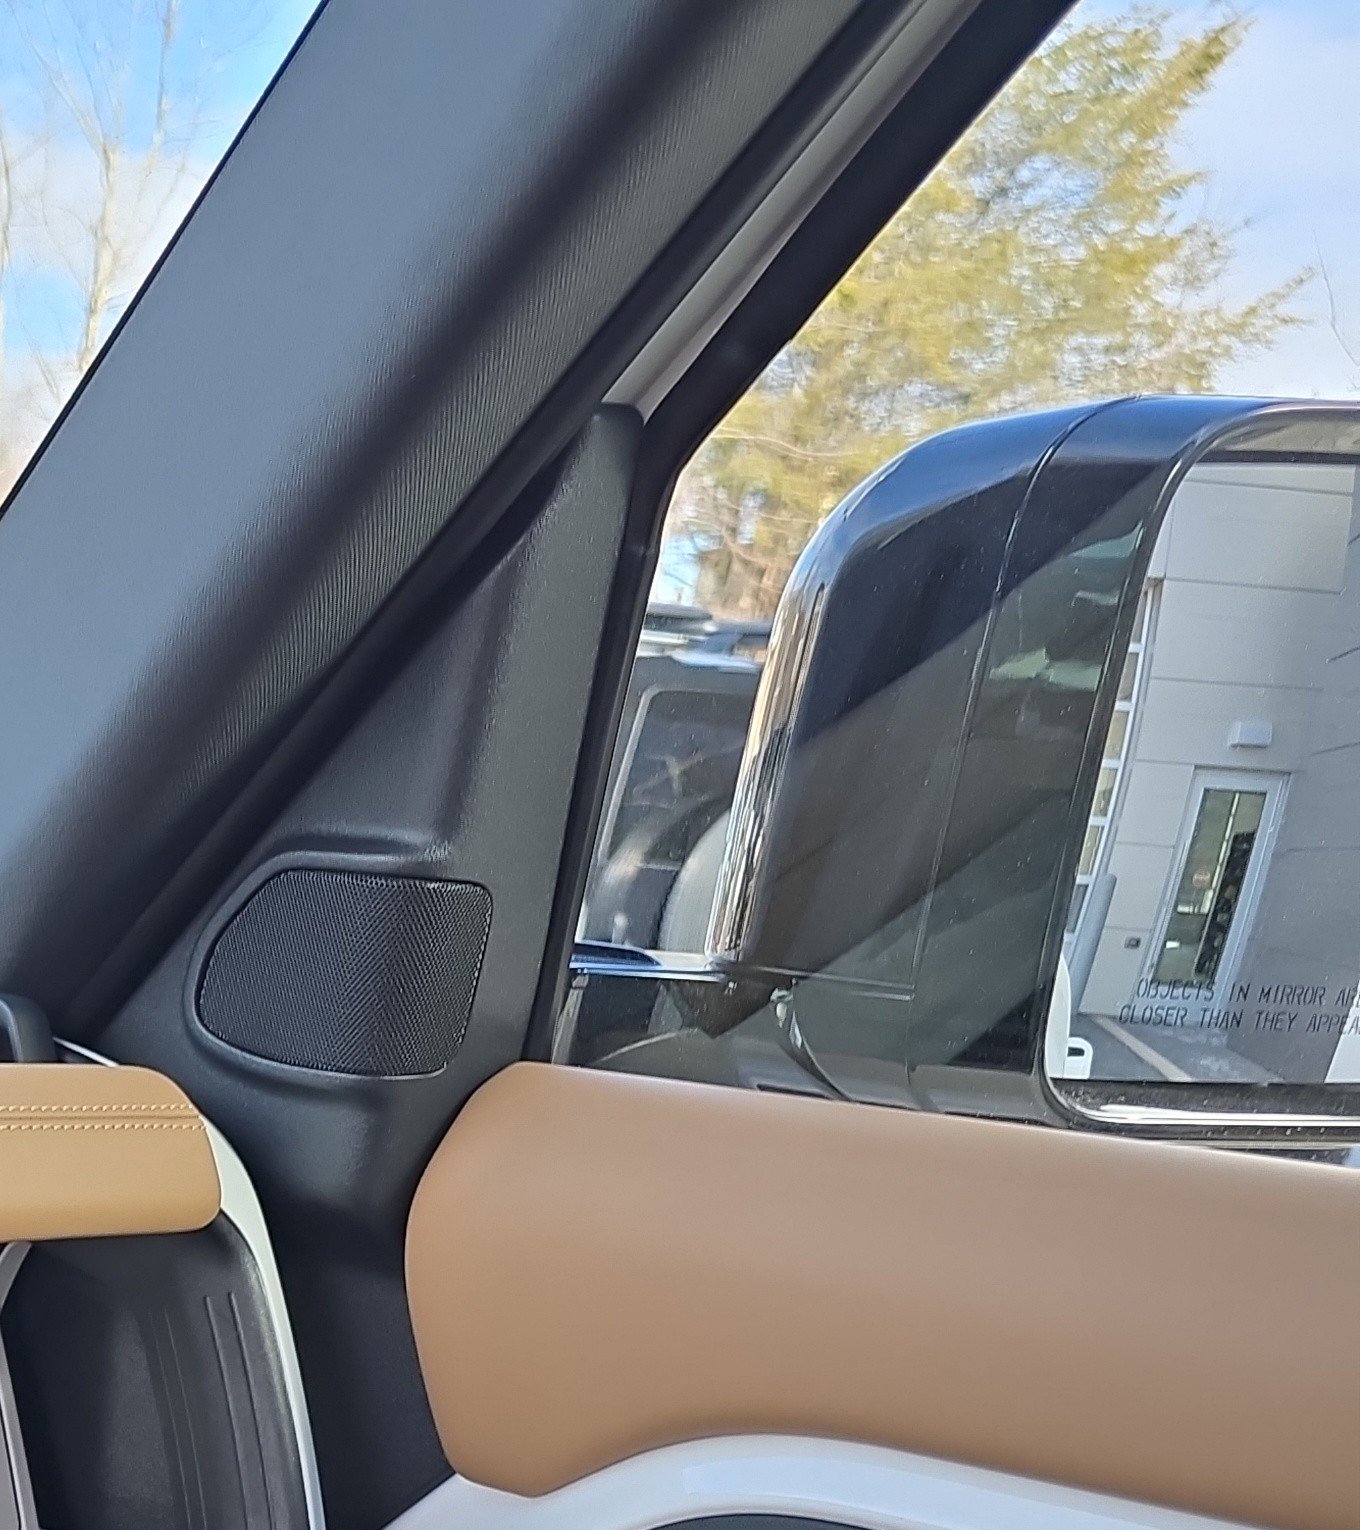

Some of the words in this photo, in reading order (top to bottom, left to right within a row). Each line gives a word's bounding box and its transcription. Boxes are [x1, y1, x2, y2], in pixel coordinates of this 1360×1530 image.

[1136, 978, 1215, 1002] OBJECTS
[1229, 981, 1250, 1003] IN
[1257, 984, 1326, 1006] MIRROR
[1118, 1004, 1189, 1028] CLOSER
[1200, 1006, 1244, 1030] THAN
[1254, 1009, 1298, 1032] THEY
[1305, 1013, 1360, 1036] APPEA
